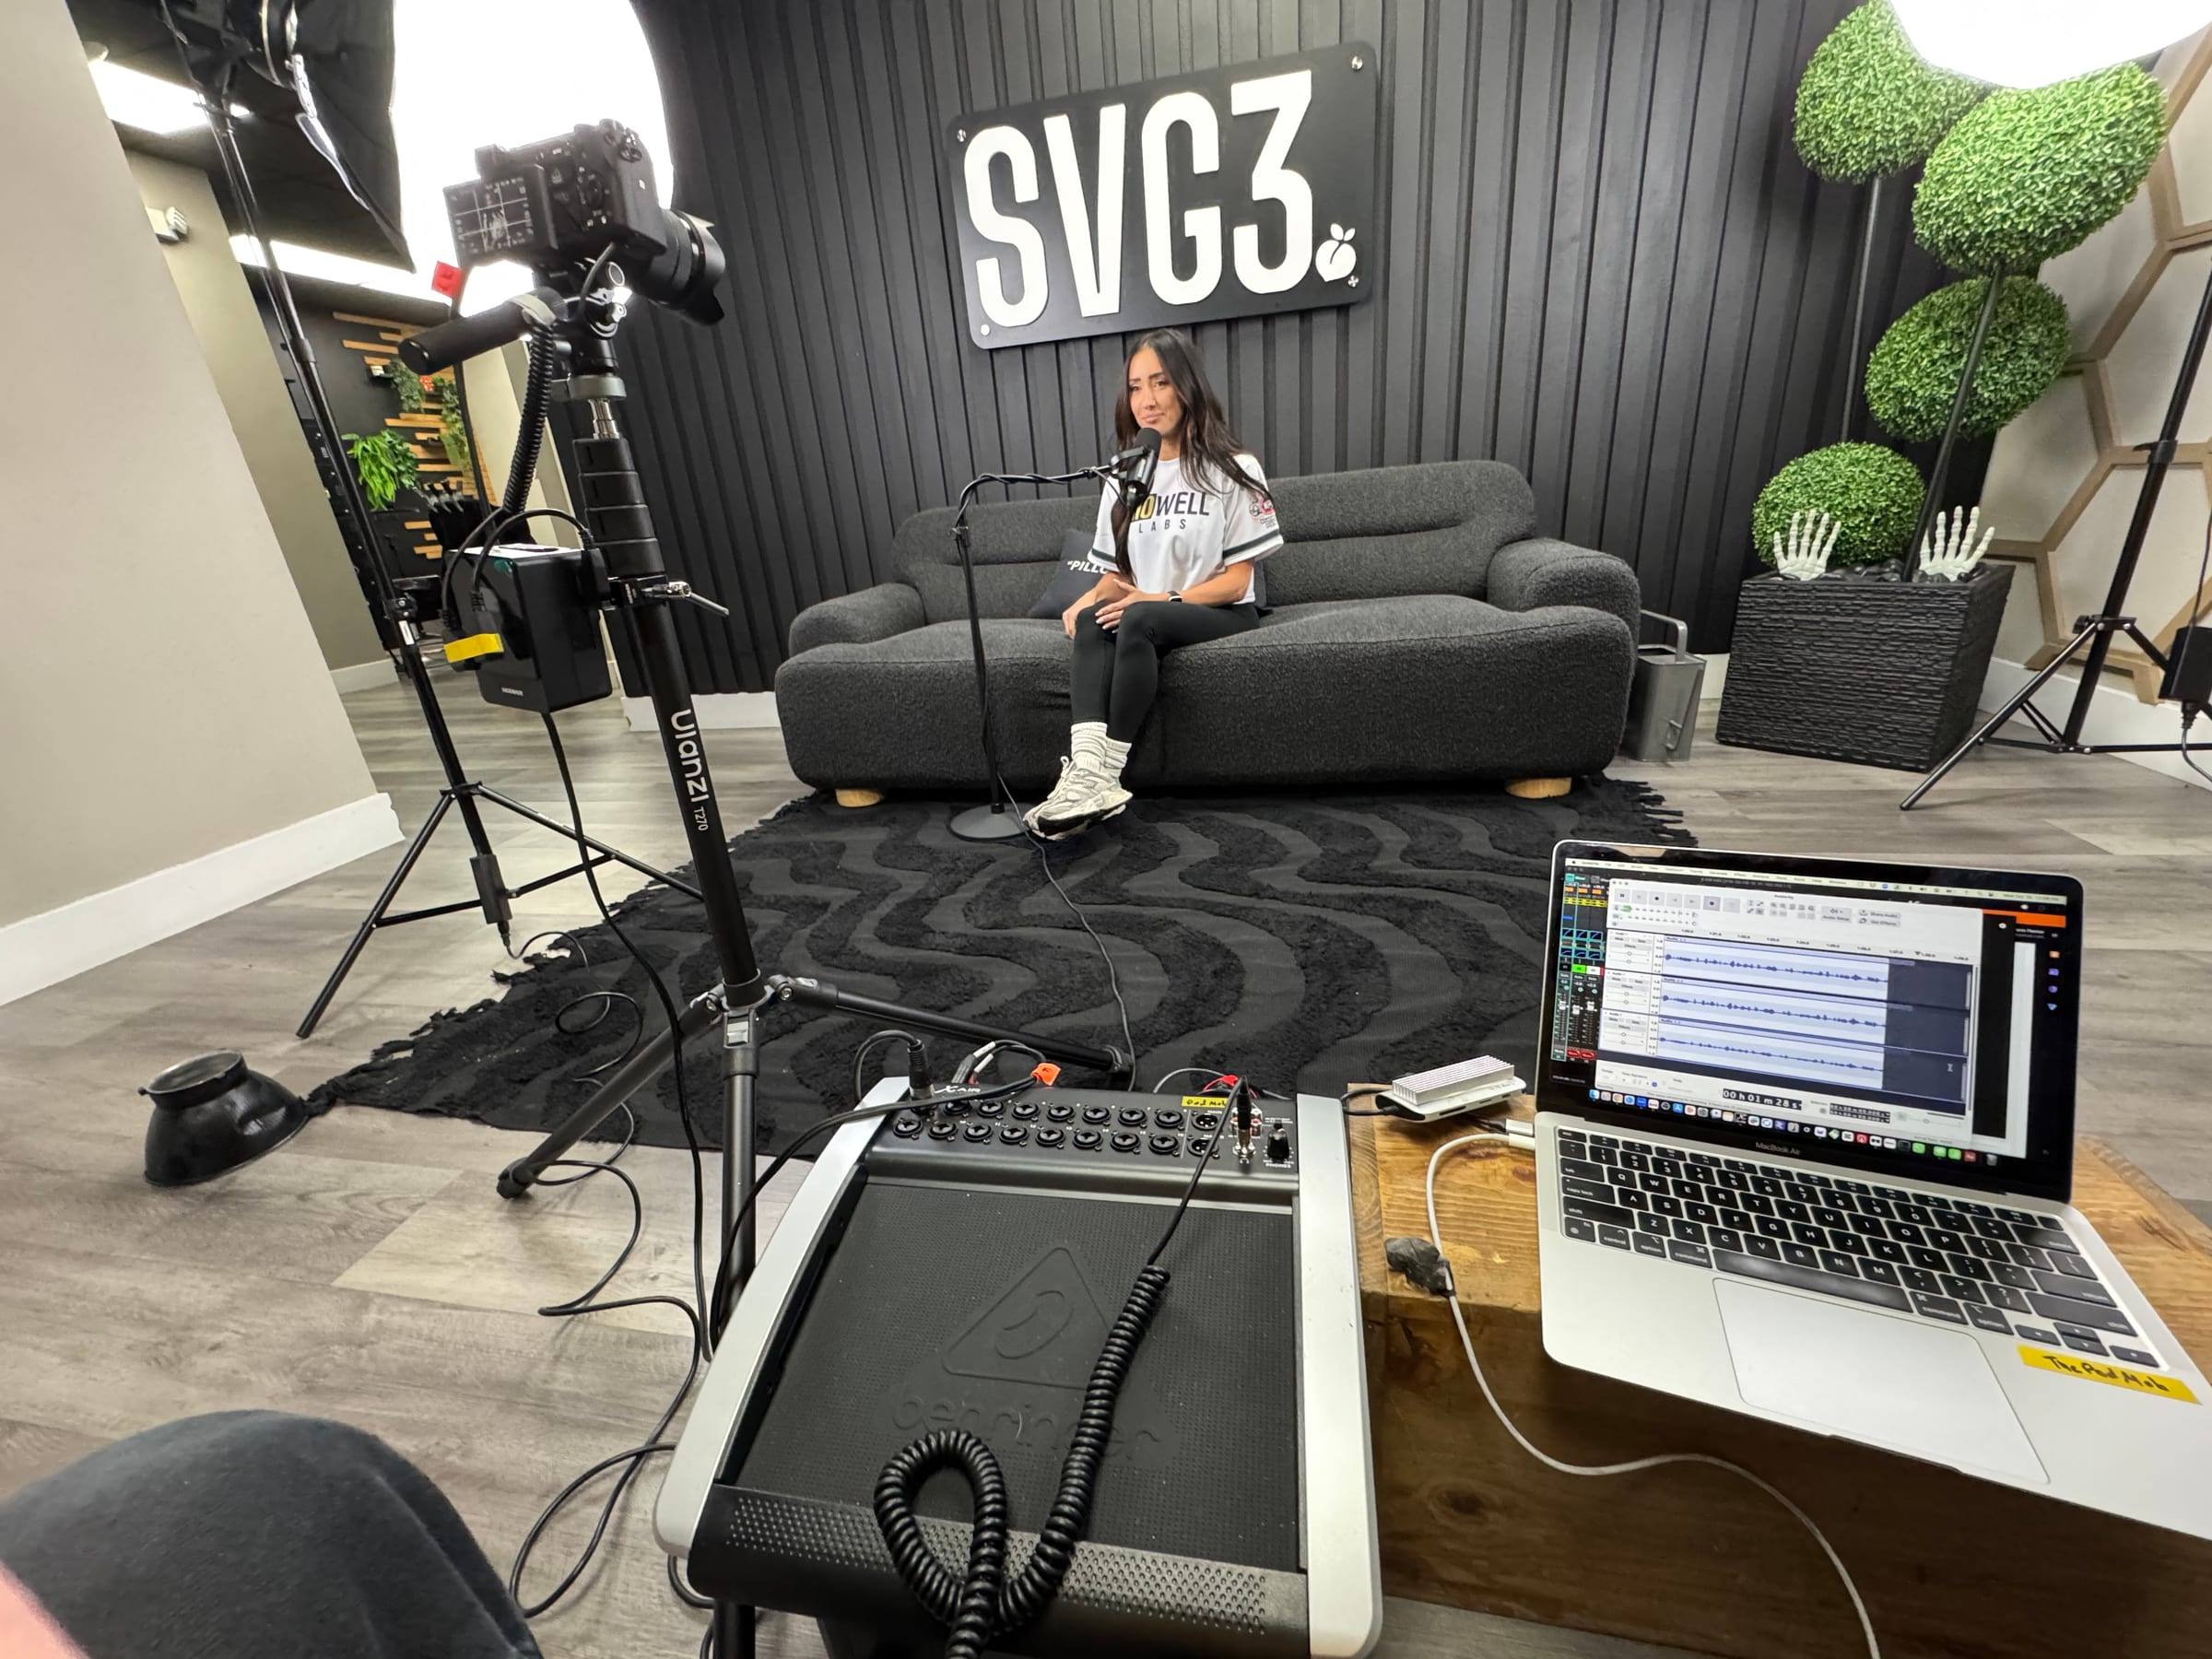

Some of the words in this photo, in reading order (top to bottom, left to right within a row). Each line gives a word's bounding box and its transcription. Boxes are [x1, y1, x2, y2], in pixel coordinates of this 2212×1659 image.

[963, 69, 1313, 327] SVG3
[1138, 518, 1186, 534] LABS
[694, 806, 709, 830] T270
[1724, 1089, 1736, 1099] 00
[1747, 1094, 1761, 1103] 01
[1775, 1099, 1790, 1108] 28
[1755, 1141, 1788, 1153] MacBook
[1788, 1147, 1801, 1156] Air
